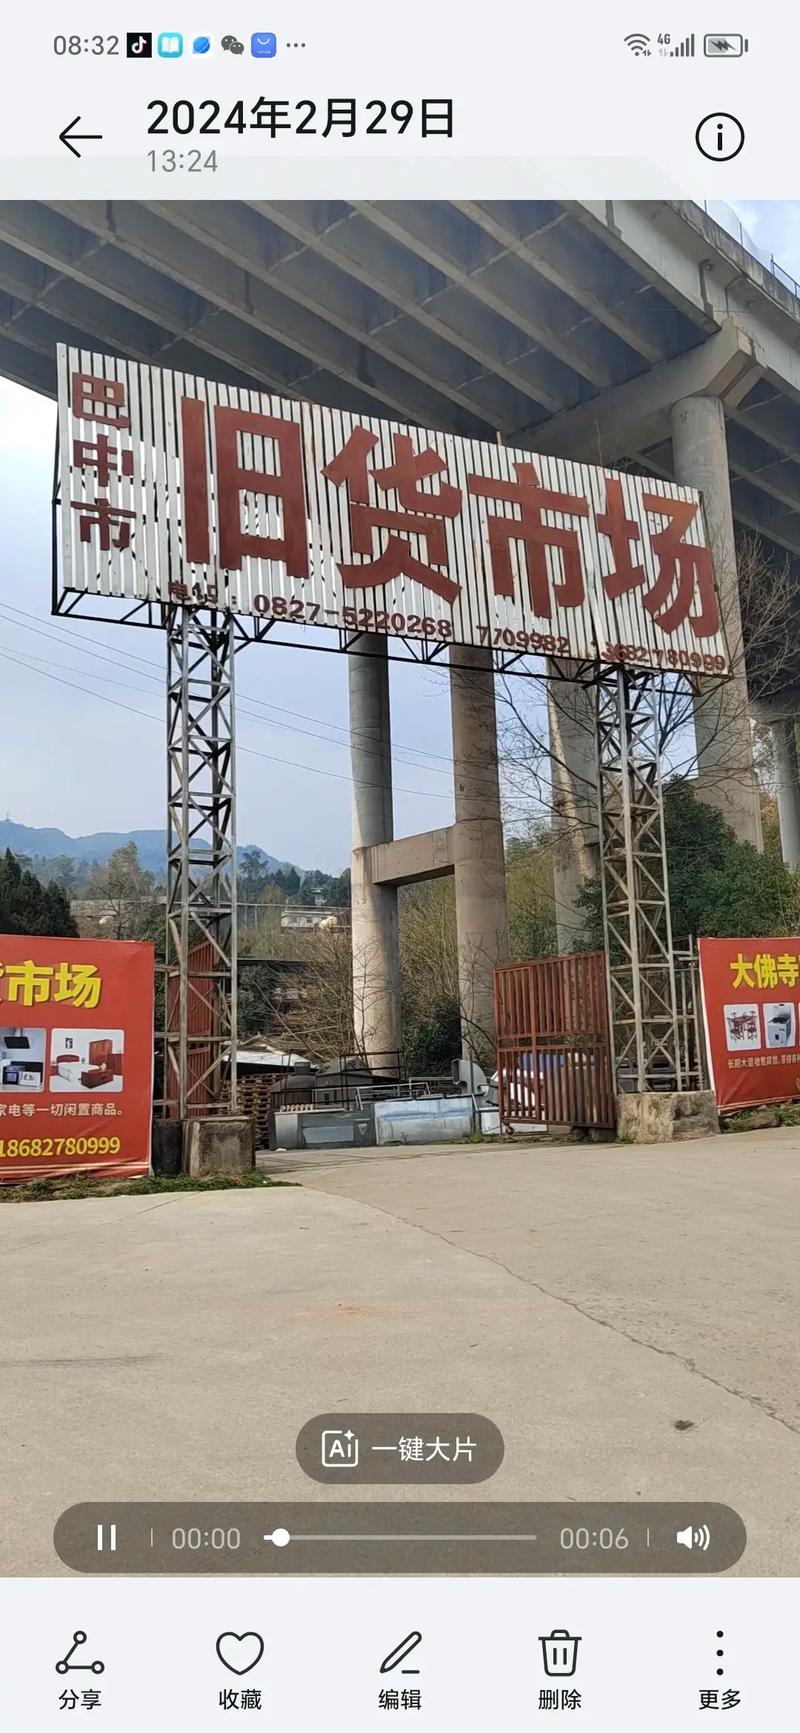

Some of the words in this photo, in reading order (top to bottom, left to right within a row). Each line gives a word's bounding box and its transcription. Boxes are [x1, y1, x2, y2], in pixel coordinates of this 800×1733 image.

[70, 372, 136, 551] 巴中市
[181, 395, 720, 638] 旧货市场
[0, 960, 102, 1008] 市场
